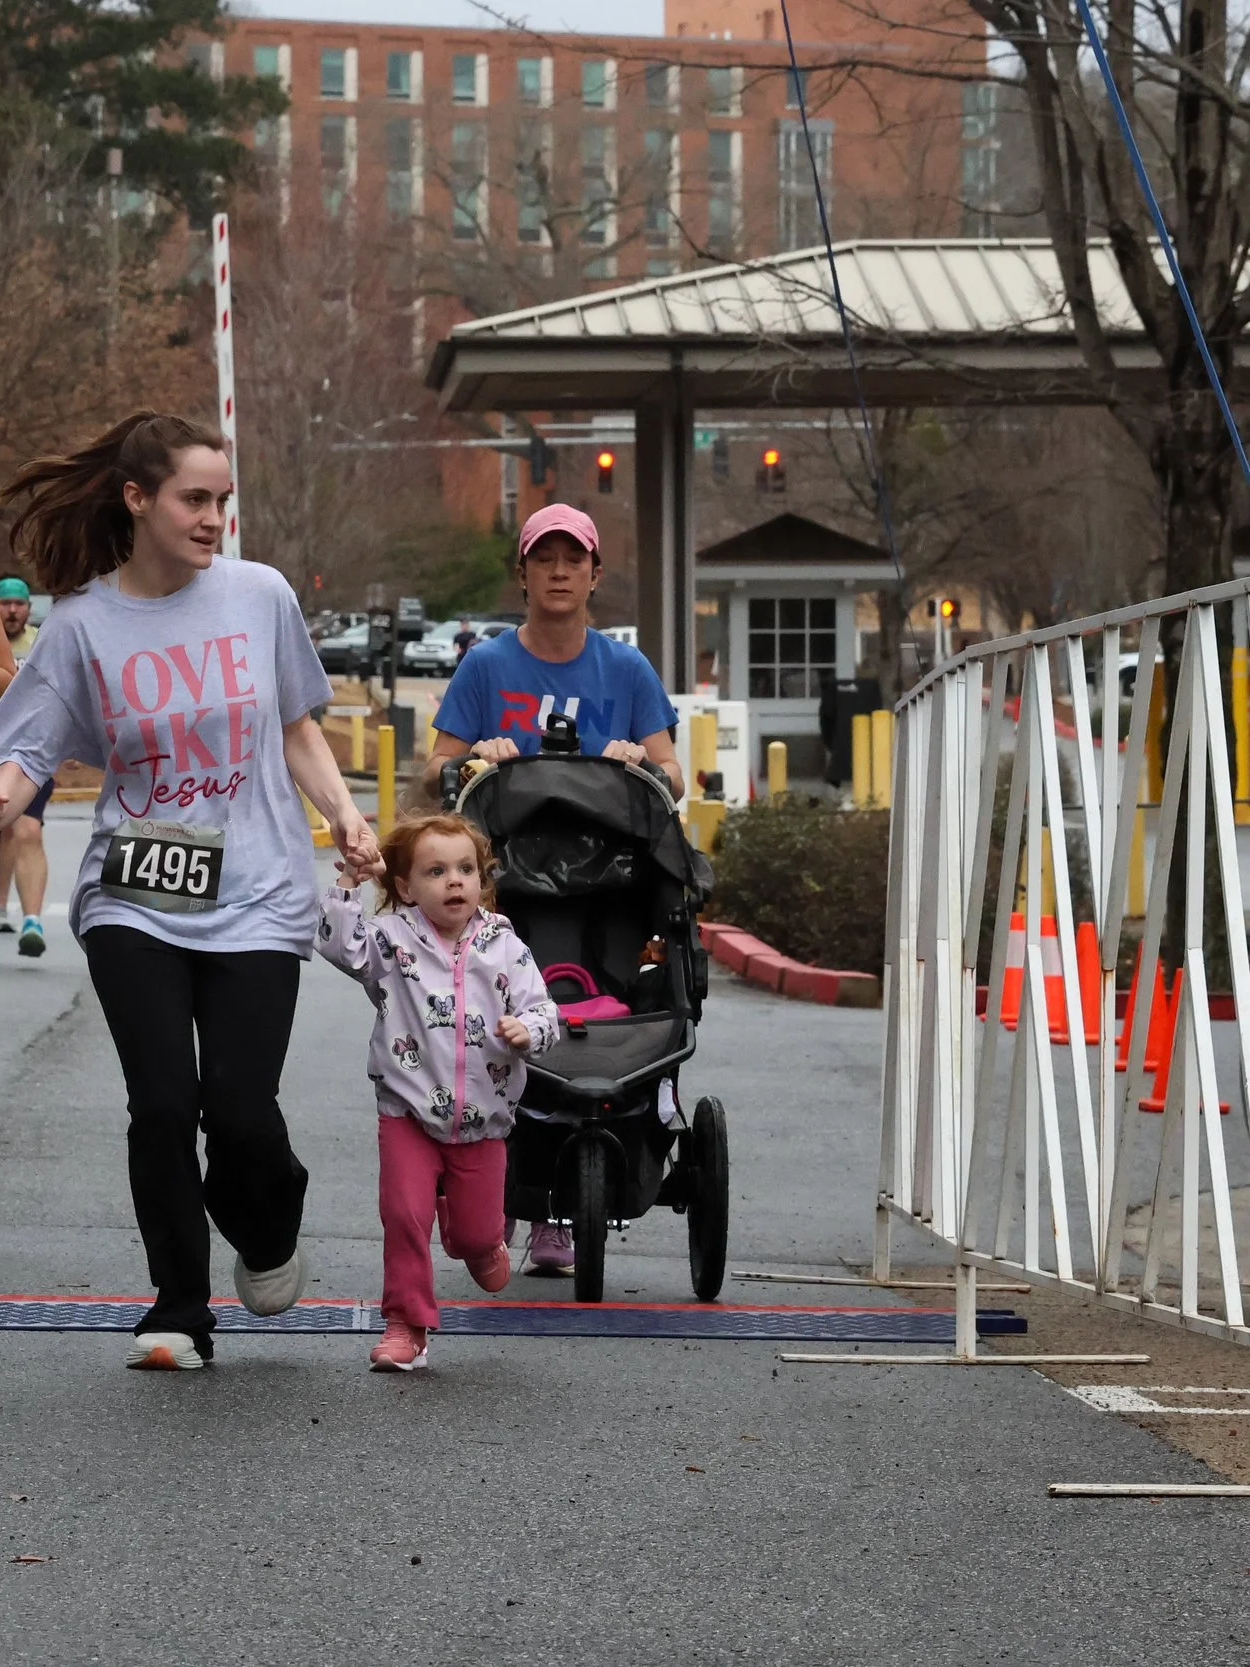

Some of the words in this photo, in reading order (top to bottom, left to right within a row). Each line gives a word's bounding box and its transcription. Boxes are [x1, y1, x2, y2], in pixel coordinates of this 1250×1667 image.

[90, 632, 255, 720] LOVE
[105, 699, 257, 776] LIKE
[498, 689, 615, 737] RUN
[116, 755, 247, 818] Jesus
[120, 841, 211, 894] 1495
